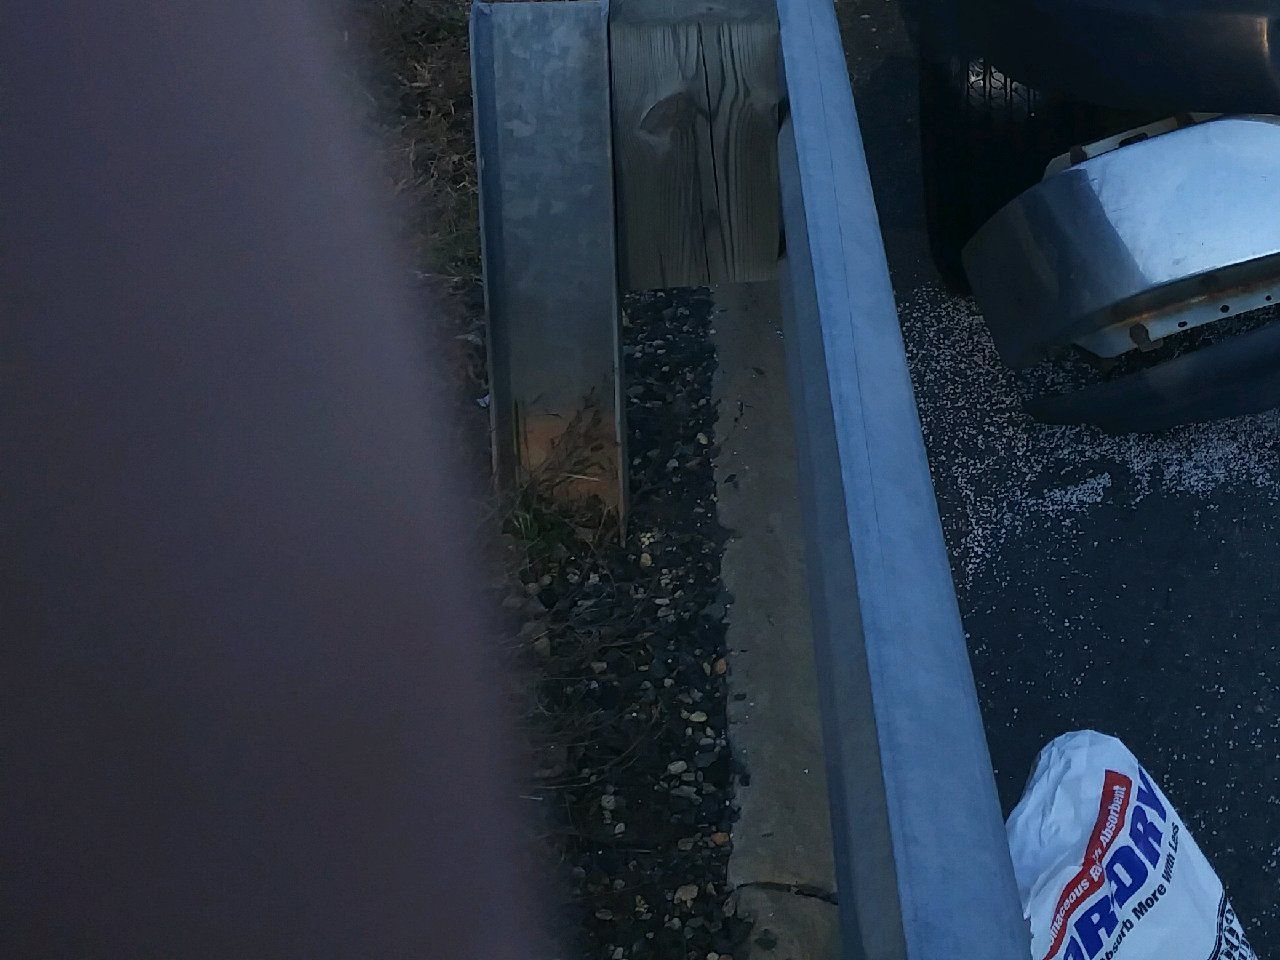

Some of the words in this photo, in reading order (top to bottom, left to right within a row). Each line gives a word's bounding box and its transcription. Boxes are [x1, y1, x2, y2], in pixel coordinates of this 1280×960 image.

[1051, 878, 1090, 944] maceous
[1100, 784, 1127, 848] Absorbent
[1099, 919, 1135, 960] bsorb
[1131, 883, 1167, 921] More
[1161, 851, 1176, 884] With
